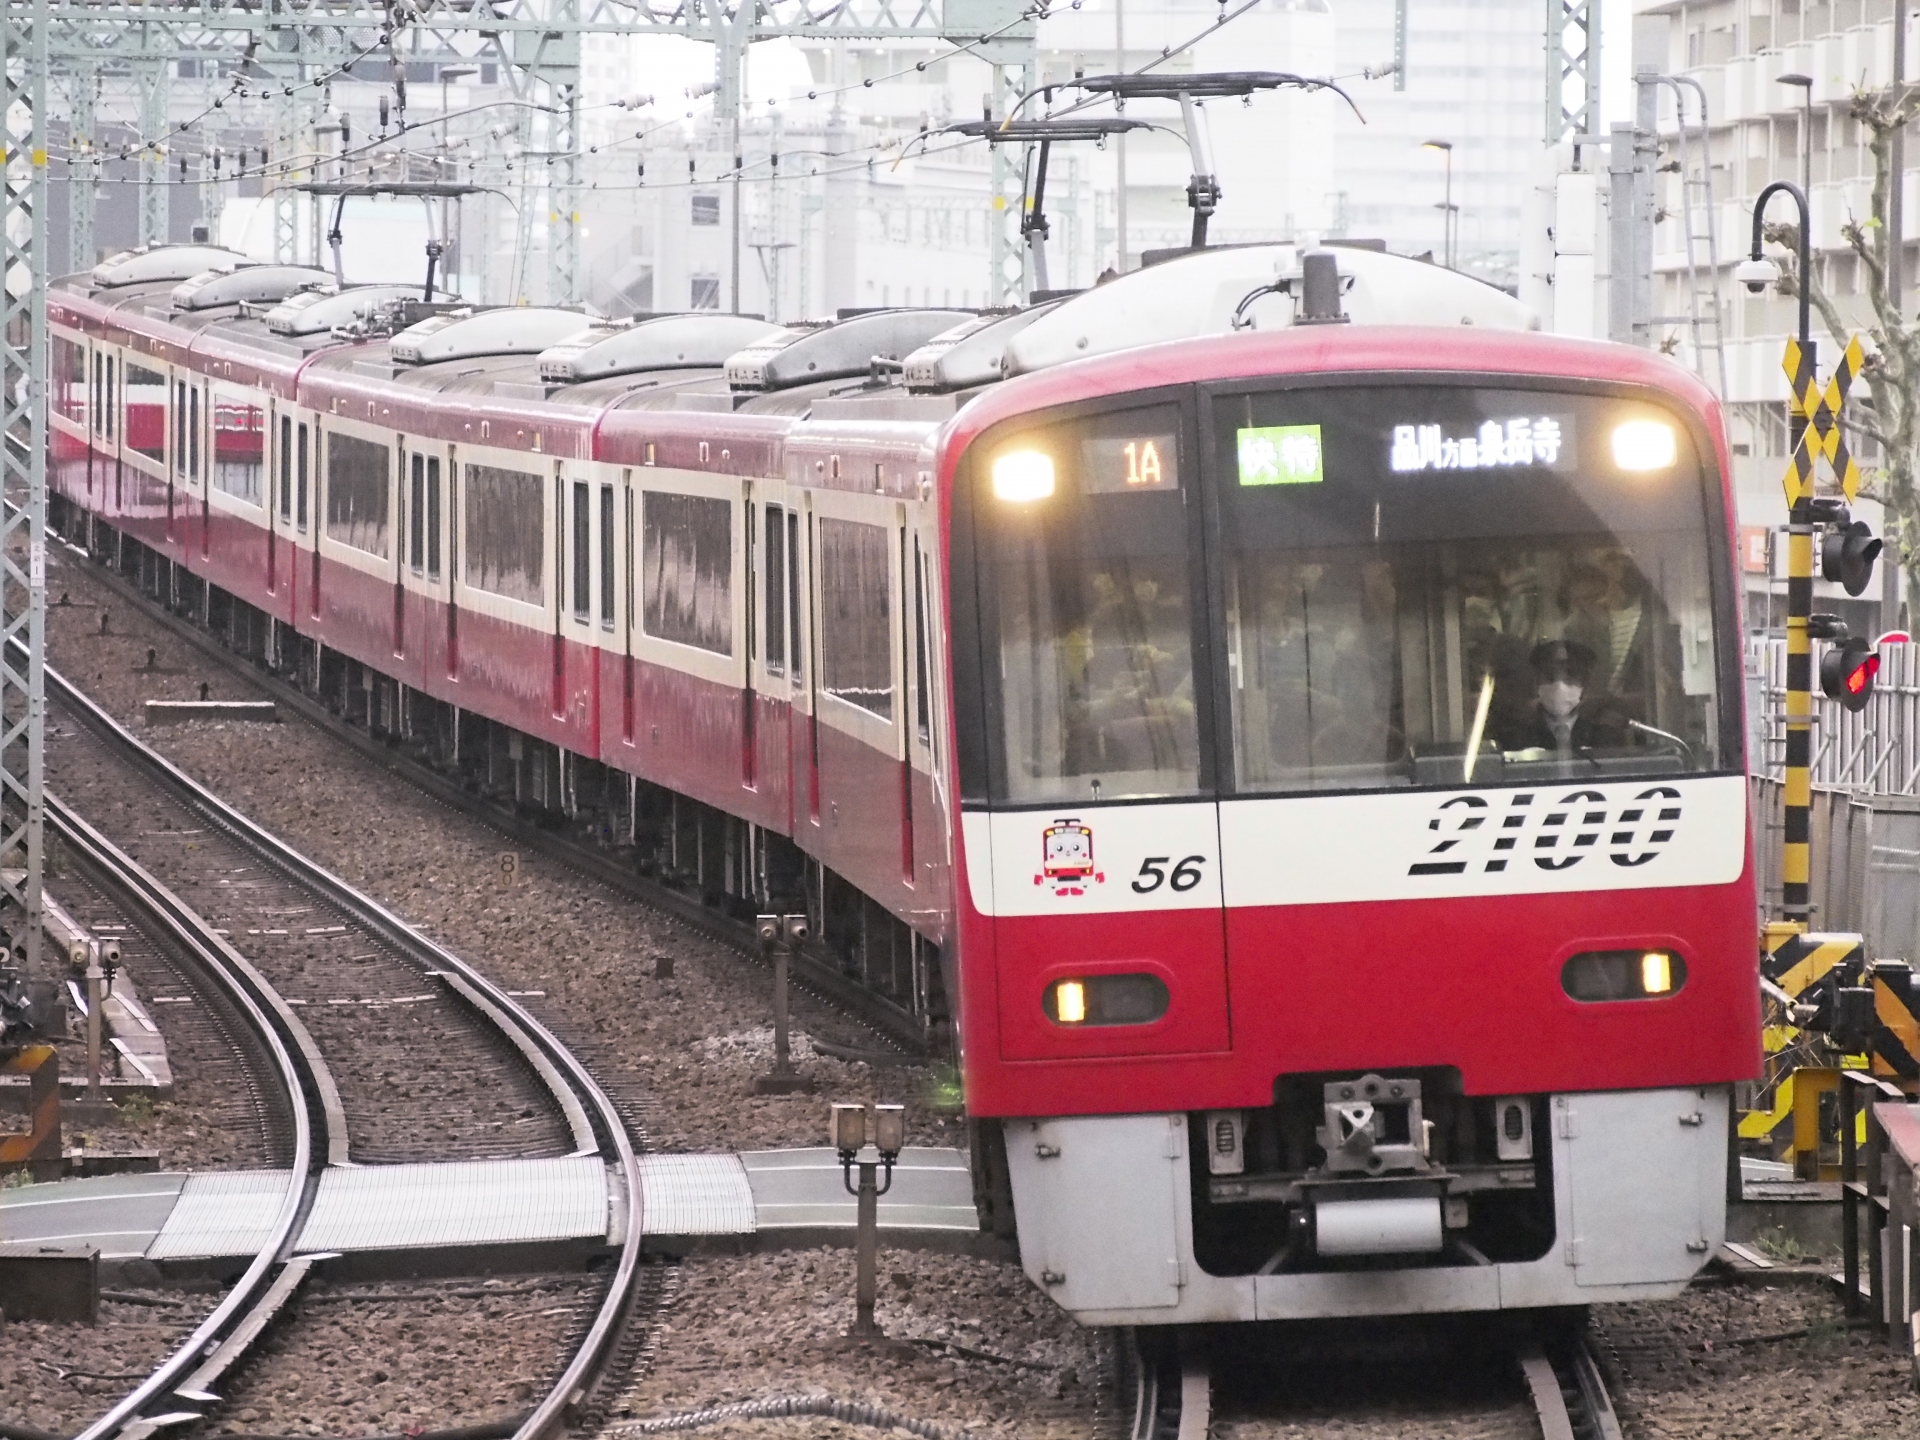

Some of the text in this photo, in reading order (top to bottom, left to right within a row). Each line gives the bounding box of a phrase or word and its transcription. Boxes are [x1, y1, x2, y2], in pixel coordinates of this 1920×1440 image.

[1123, 440, 1161, 484] 1A
[1239, 434, 1320, 478] 快特
[1407, 786, 1682, 876] 2100
[1131, 854, 1207, 894] 56
